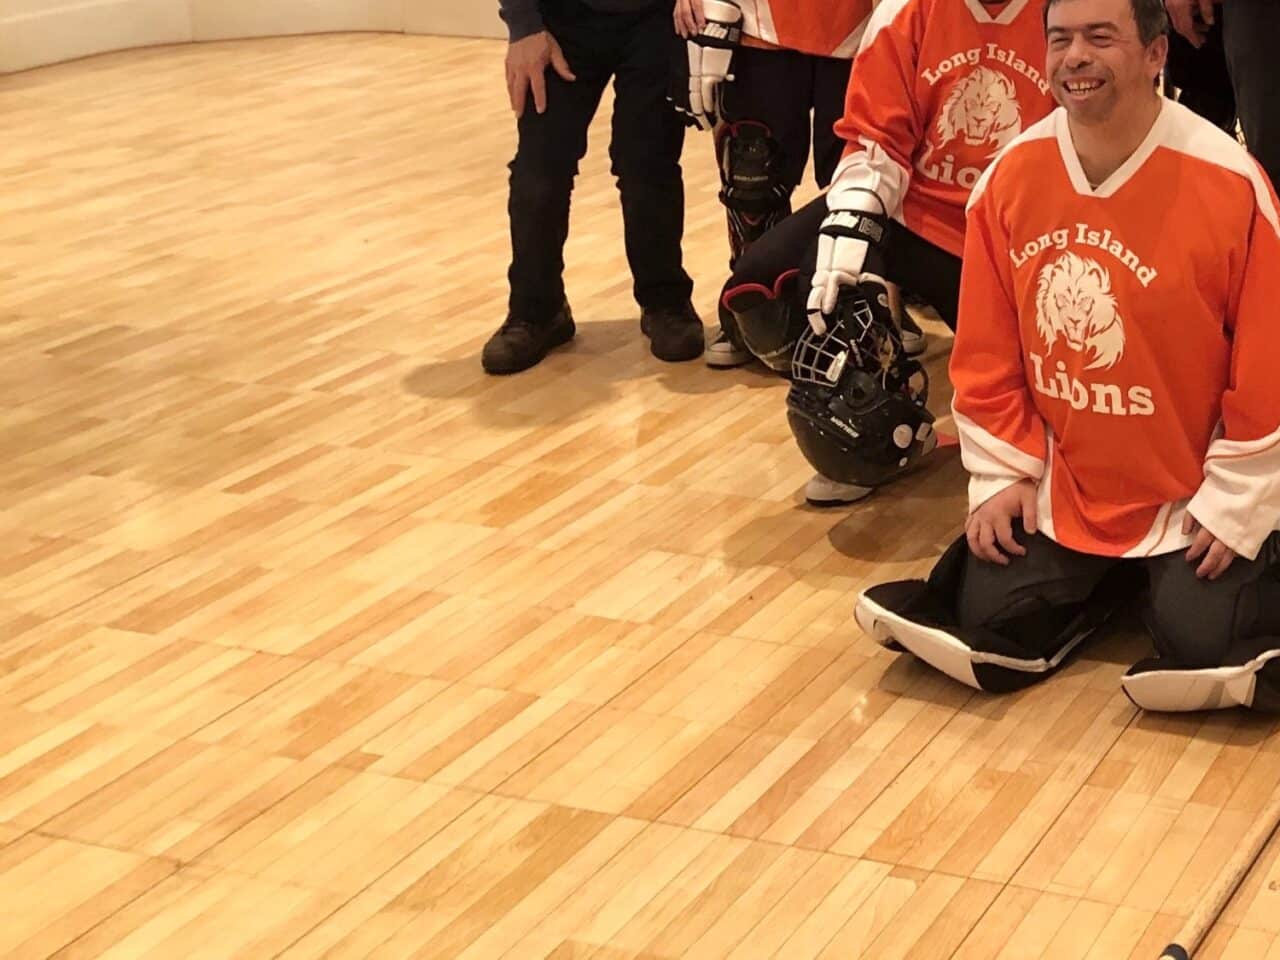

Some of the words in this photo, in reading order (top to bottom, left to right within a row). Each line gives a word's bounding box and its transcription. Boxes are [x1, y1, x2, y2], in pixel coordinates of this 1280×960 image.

[921, 48, 981, 86] Long
[986, 43, 1051, 96] Island
[915, 140, 983, 189] Lio
[1010, 228, 1070, 268] Long
[1075, 223, 1157, 288] Island
[1029, 352, 1155, 416] Lions
